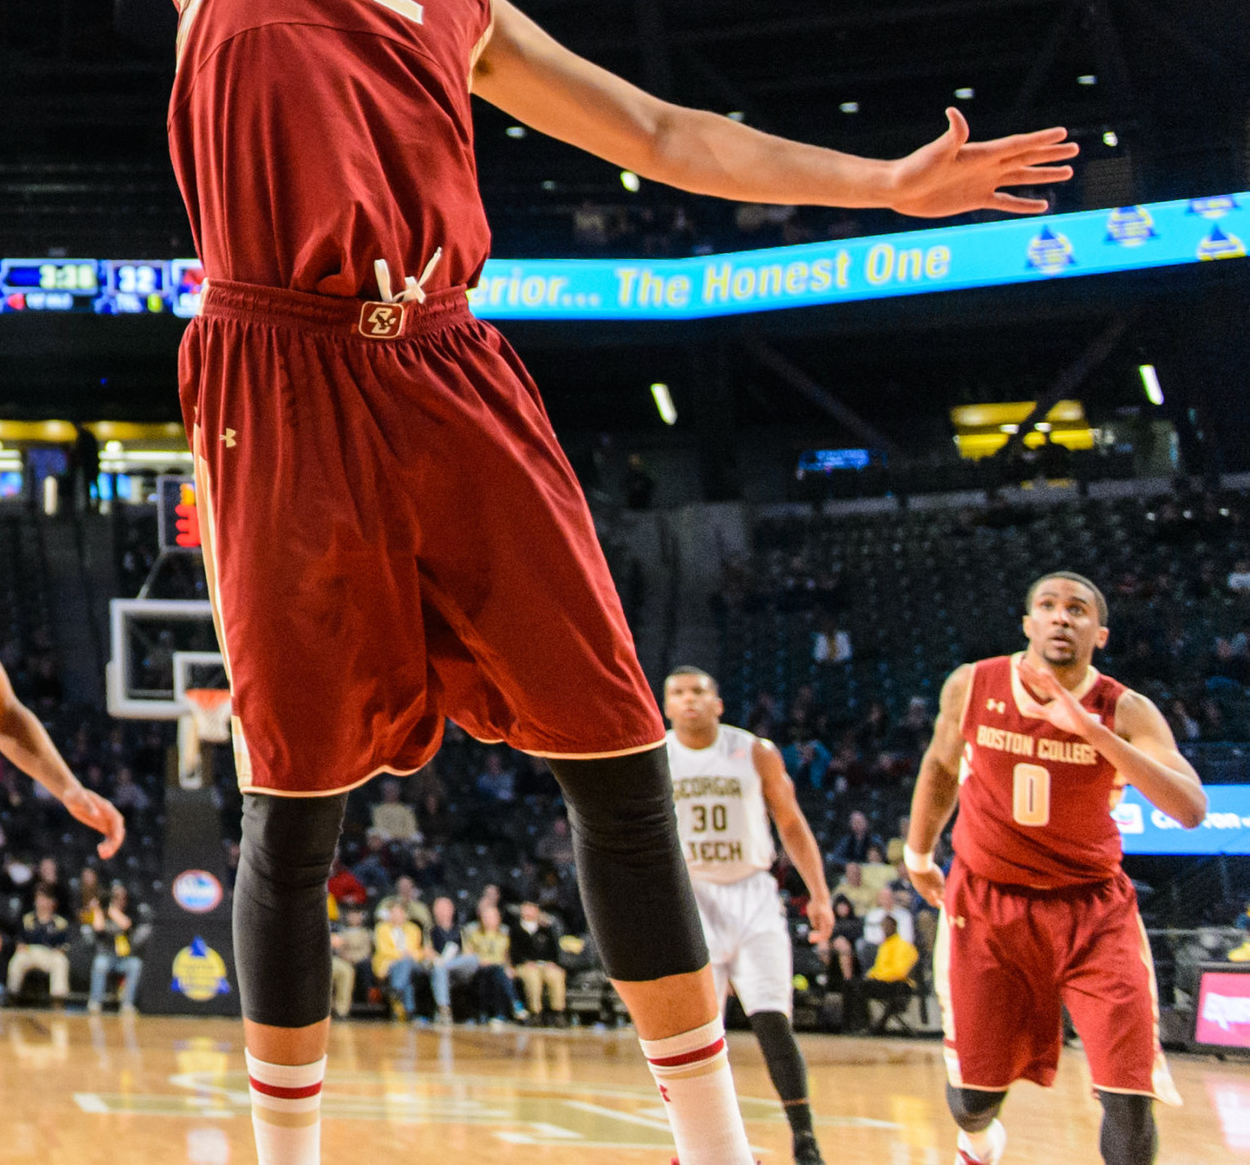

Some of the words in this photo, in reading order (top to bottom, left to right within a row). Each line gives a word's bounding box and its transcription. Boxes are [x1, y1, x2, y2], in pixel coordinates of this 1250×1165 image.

[466, 267, 600, 308] erior...
[615, 266, 691, 306] The
[701, 248, 851, 304] Honest
[864, 241, 952, 286] One
[976, 725, 1034, 758] BOSTON
[1037, 738, 1098, 765] COLLEGE
[1012, 762, 1051, 827] 0
[691, 804, 727, 833] 30
[687, 840, 743, 864] TECH
